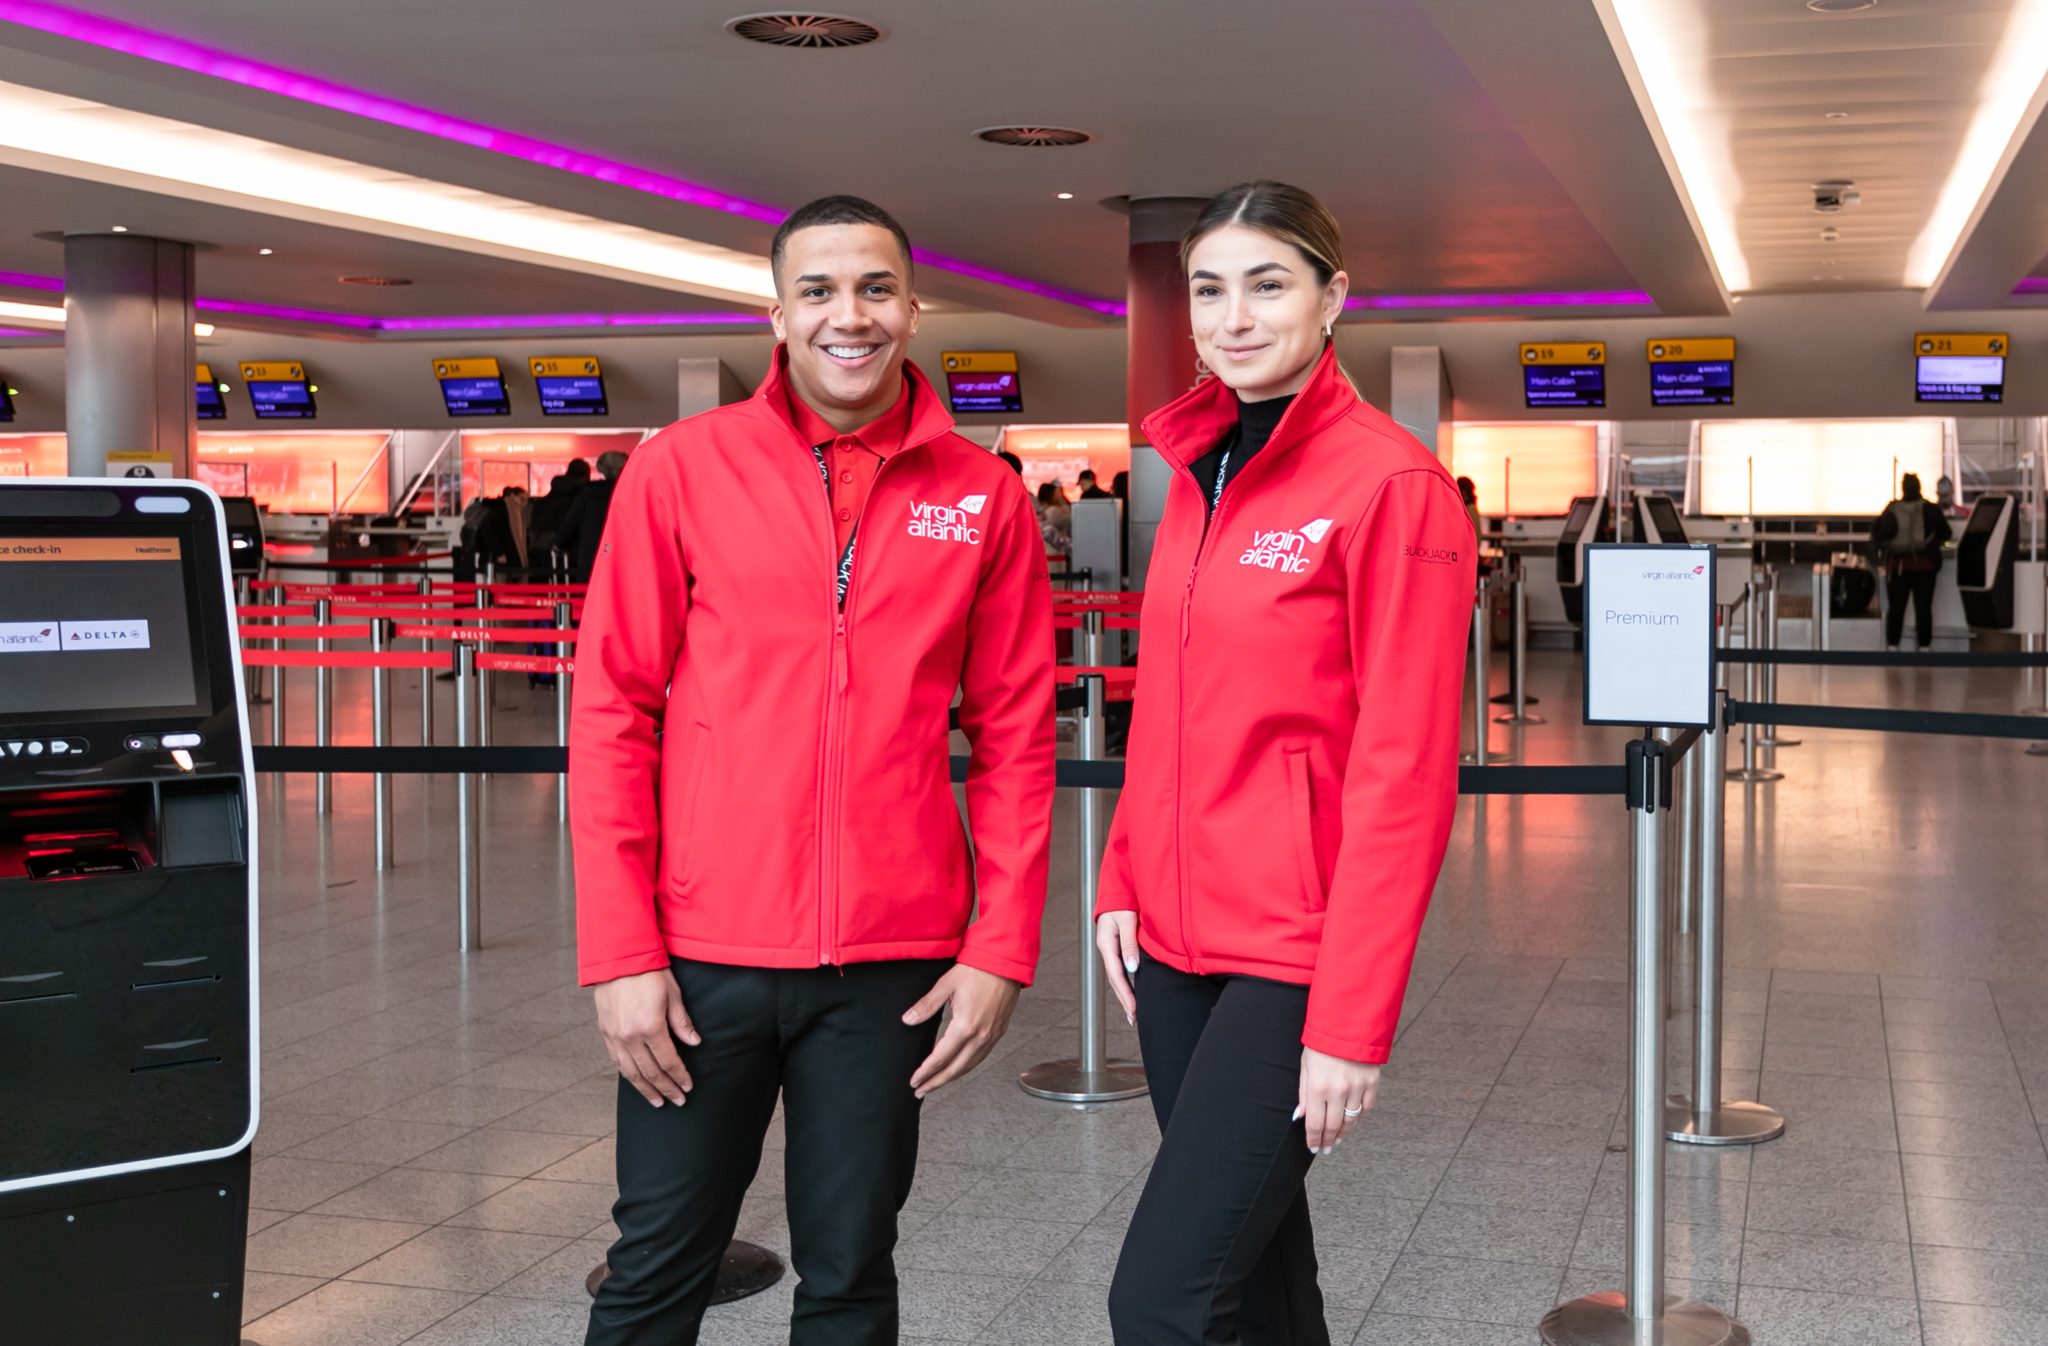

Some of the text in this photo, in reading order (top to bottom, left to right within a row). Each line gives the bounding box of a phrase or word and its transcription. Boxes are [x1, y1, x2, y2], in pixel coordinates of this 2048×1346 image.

[1669, 345, 1683, 355] 20
[1937, 340, 1951, 351] 21
[910, 500, 967, 525] virgin
[907, 518, 980, 545] atlantic
[13, 545, 62, 554] check-in
[1403, 545, 1450, 560] BLACKJACK
[1239, 547, 1310, 573] atlantic
[1641, 571, 1695, 581] virgin atlantic
[1605, 610, 1679, 625] Premium
[6, 634, 44, 644] atlantic
[84, 631, 127, 640] DELTA
[460, 630, 491, 640] DELTA
